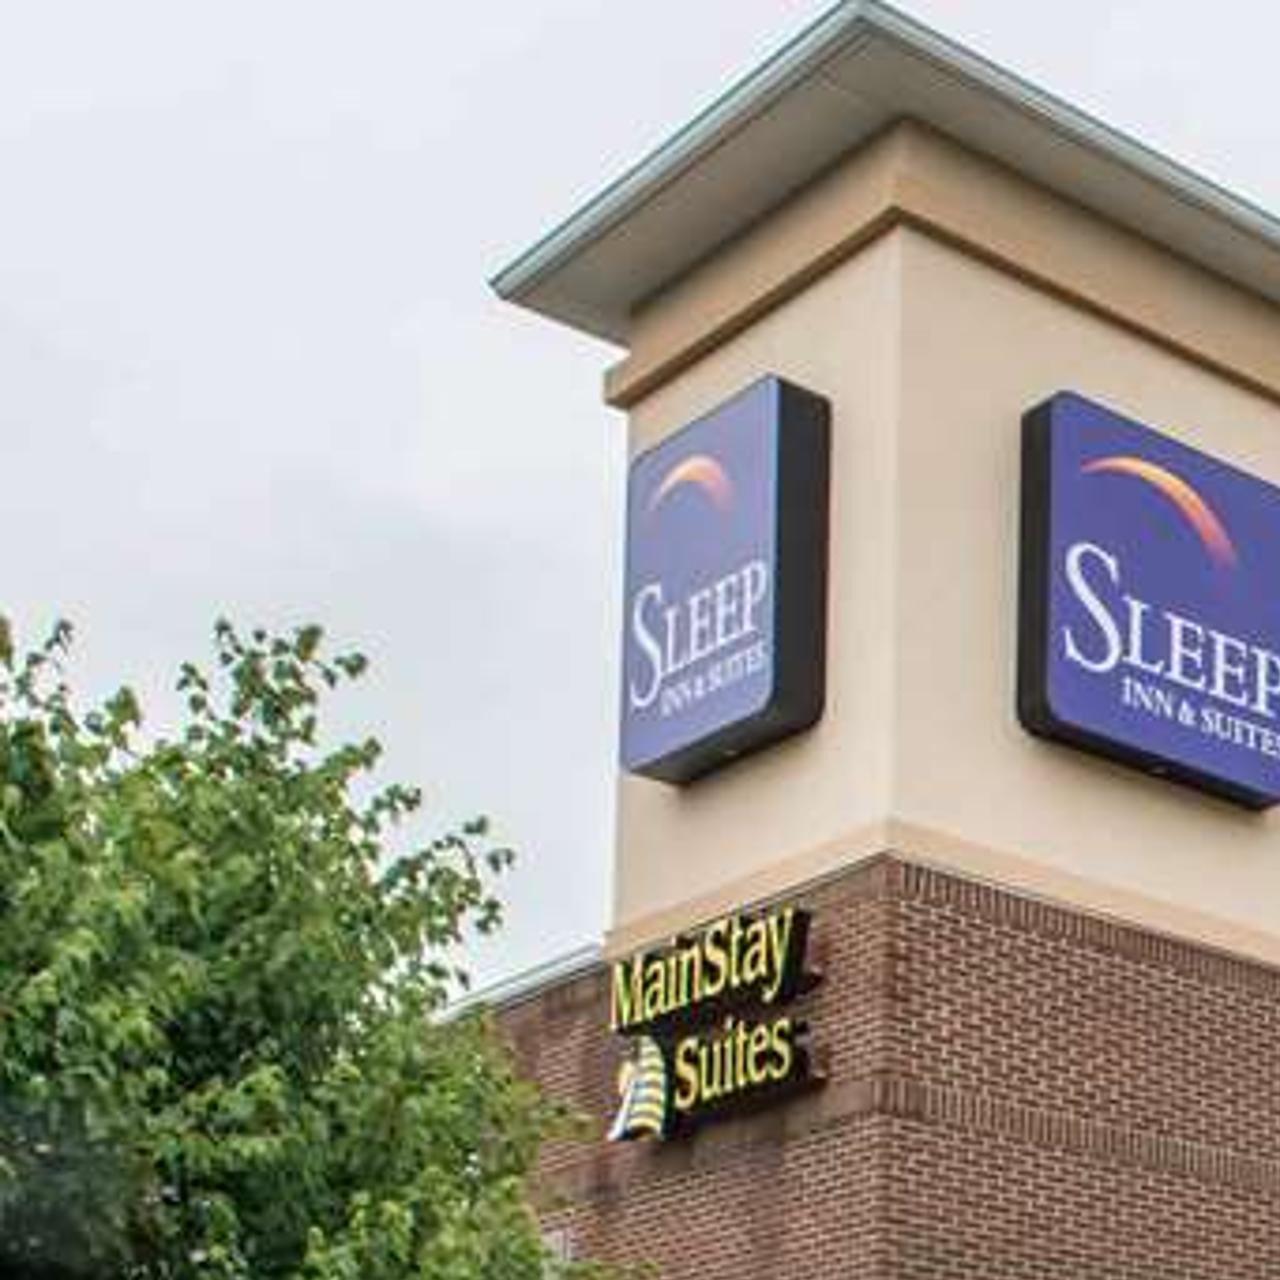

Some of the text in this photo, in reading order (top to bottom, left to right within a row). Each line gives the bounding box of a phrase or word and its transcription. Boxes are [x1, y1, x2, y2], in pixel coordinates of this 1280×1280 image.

[629, 561, 767, 707] SLEEP
[1122, 676, 1174, 719] INN
[1177, 699, 1195, 726] &
[610, 907, 795, 1032] MainStay
[674, 1016, 791, 1109] Suites
